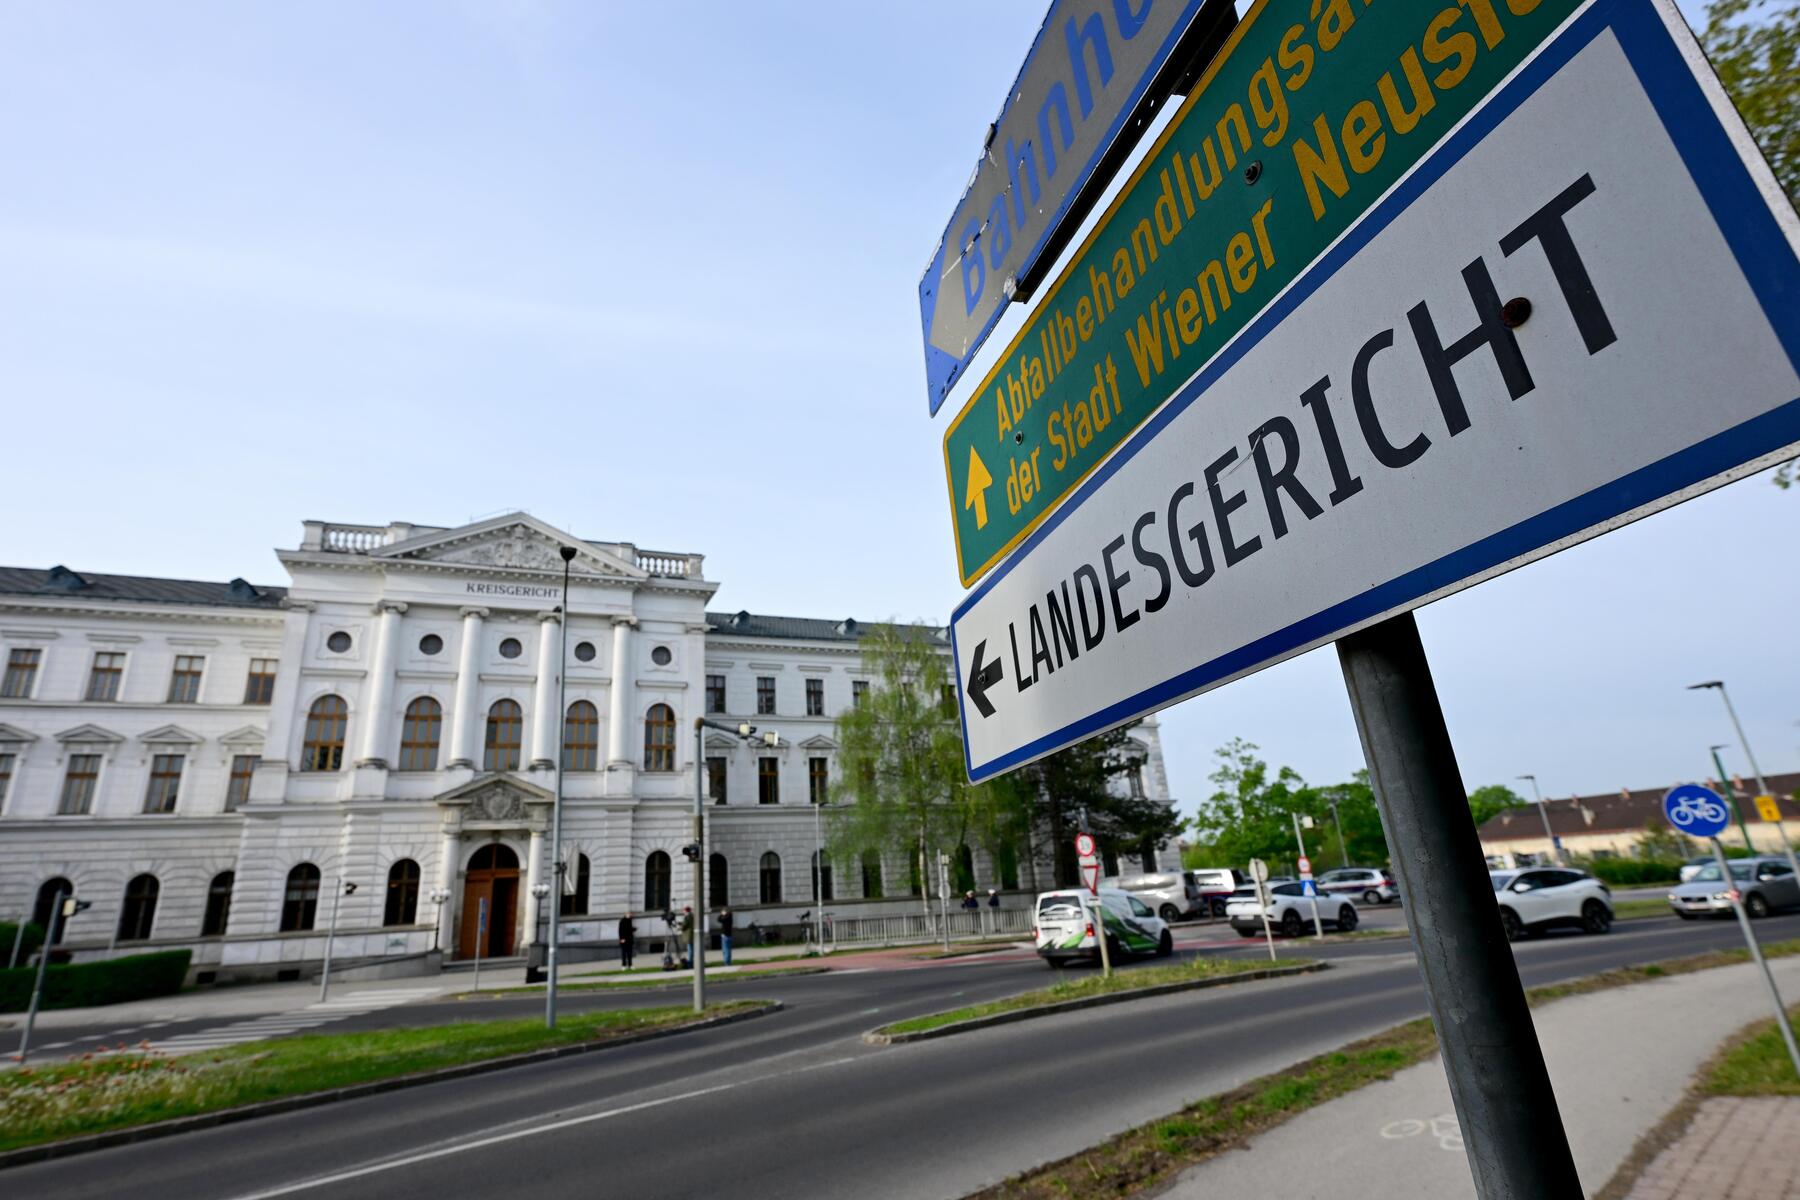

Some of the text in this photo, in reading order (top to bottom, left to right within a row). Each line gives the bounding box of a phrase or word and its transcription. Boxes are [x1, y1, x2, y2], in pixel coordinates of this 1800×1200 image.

[996, 0, 1371, 441] Abfallbehandlungsa
[1006, 0, 1543, 516] der Stadt Wiener Neust
[1008, 172, 1617, 692] LANDESGERICHT
[466, 583, 560, 597] KREISGERICHT
